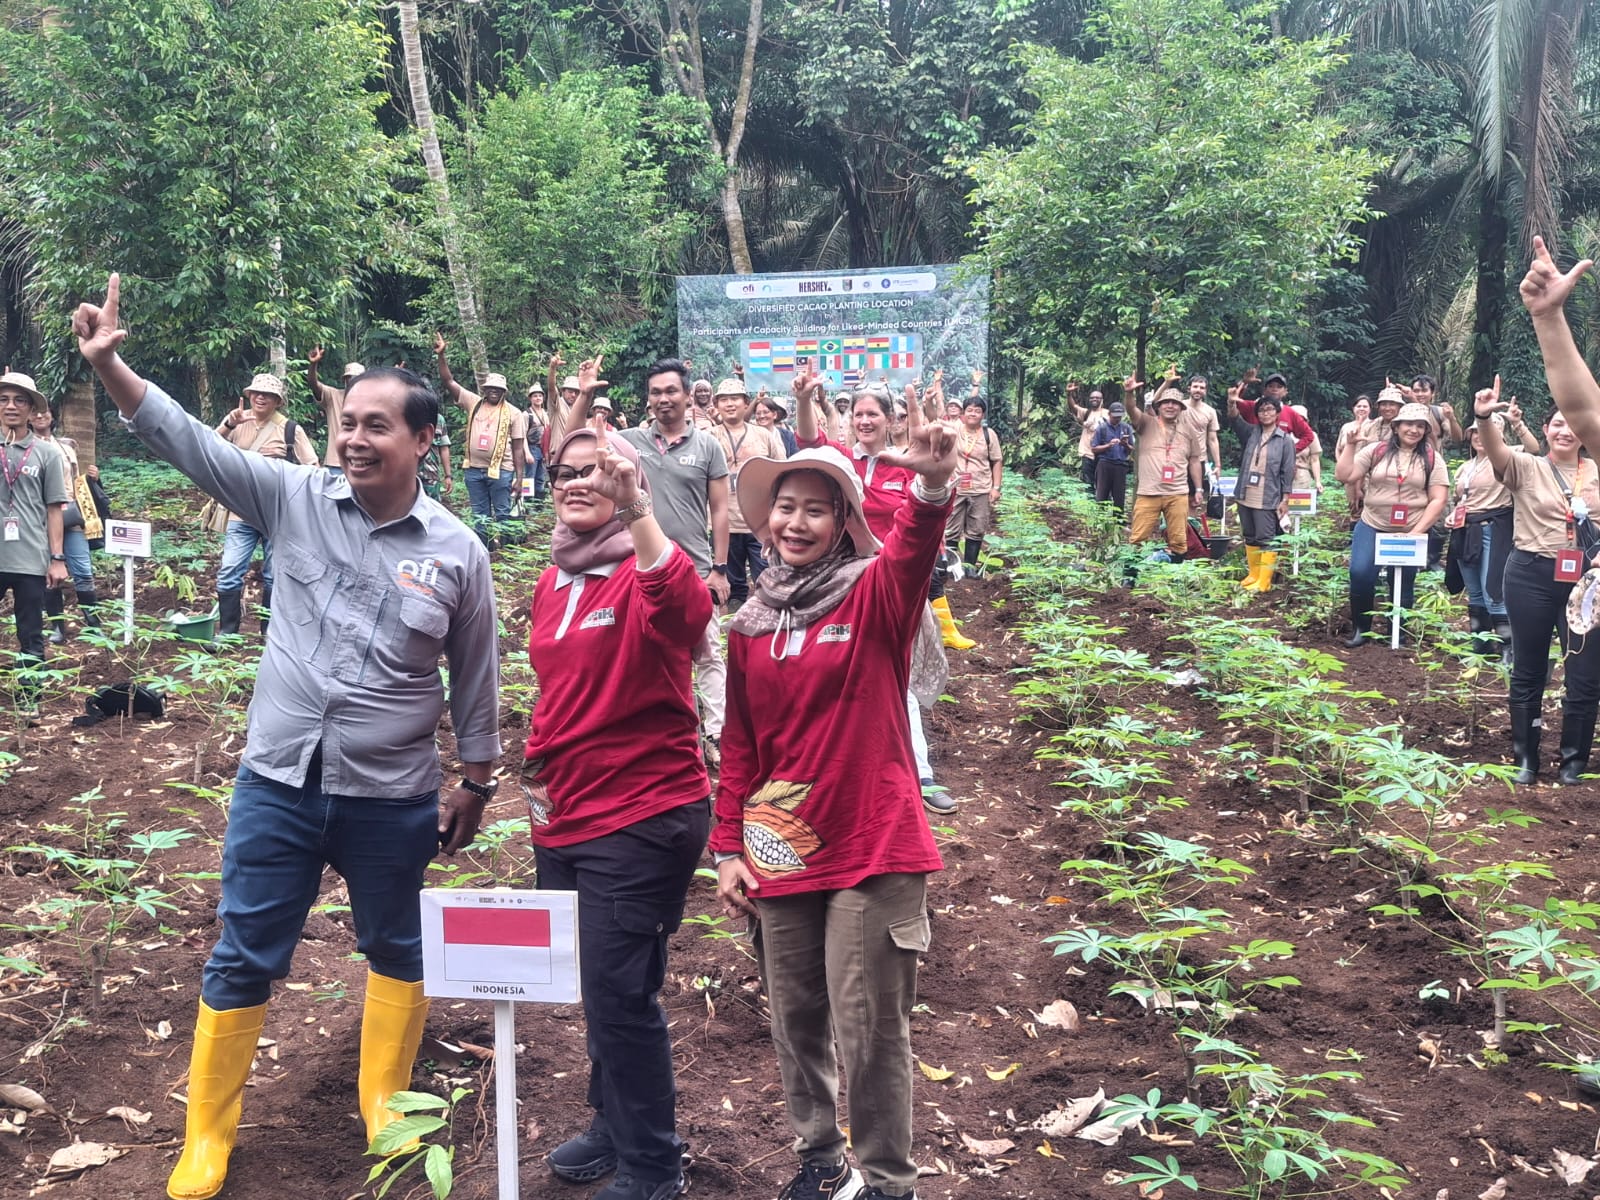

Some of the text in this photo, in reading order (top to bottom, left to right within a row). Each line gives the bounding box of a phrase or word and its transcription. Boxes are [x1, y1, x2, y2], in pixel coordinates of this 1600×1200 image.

[742, 283, 755, 293] ofi
[798, 280, 829, 293] HERSHEY
[748, 298, 914, 313] DIVERSIFIED CACAO PLANTING LOCATION
[692, 326, 741, 337] Participants
[743, 325, 753, 334] of
[753, 325, 791, 336] Capacity
[793, 323, 826, 335] Building
[827, 321, 841, 331] for
[841, 319, 900, 331] Liked-Minded
[901, 318, 943, 329] Countries
[679, 454, 697, 466] ofi
[21, 465, 40, 478] ofi
[397, 558, 443, 586] ofi
[472, 984, 526, 995] INDONESIA
